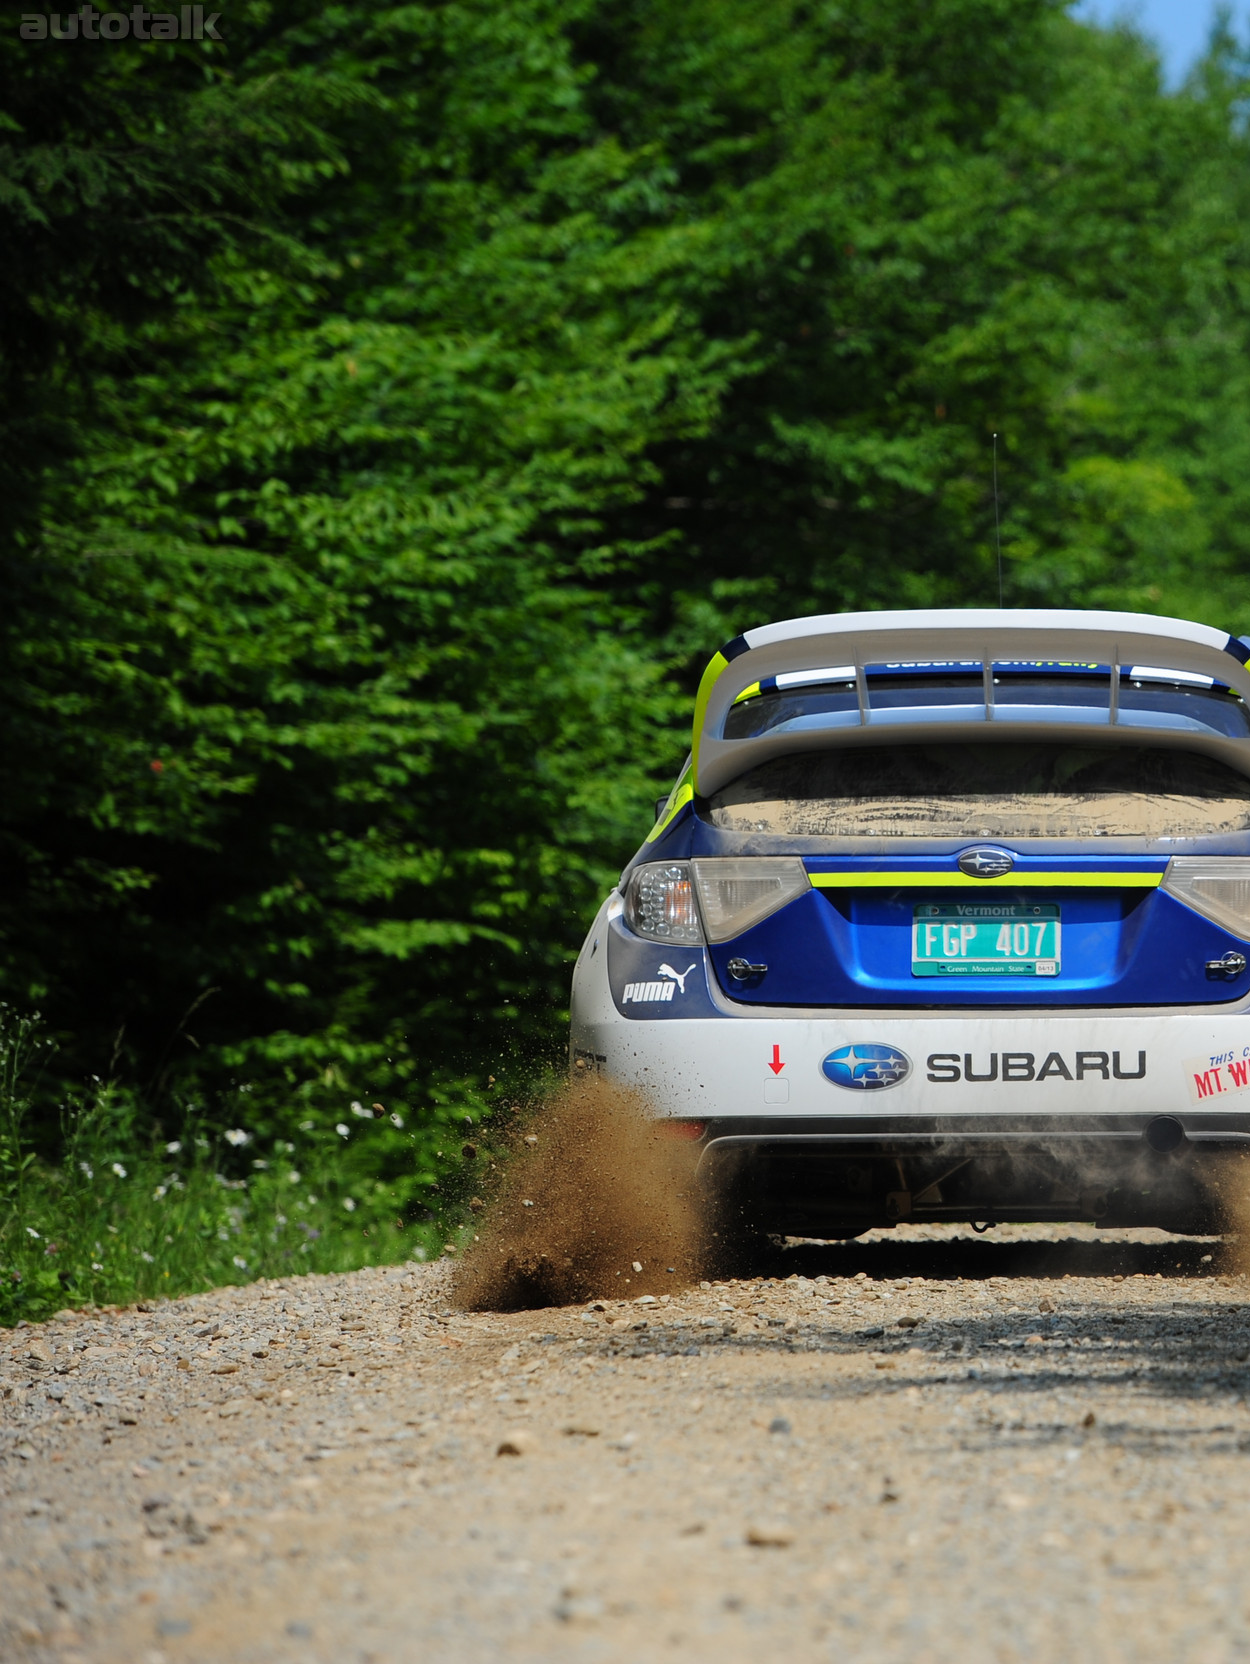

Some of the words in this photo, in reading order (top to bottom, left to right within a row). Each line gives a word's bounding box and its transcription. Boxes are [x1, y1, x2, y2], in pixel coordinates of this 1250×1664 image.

[956, 905, 1016, 916] Vermont
[925, 921, 977, 956] FGP
[995, 921, 1048, 956] 407
[947, 965, 968, 973] Green
[971, 965, 1005, 973] Mountain
[1008, 965, 1025, 973] State
[622, 981, 675, 1004] PUMA
[927, 1050, 1146, 1083] SUBARU
[1209, 1051, 1235, 1067] THIS
[1193, 1067, 1227, 1098] MT.
